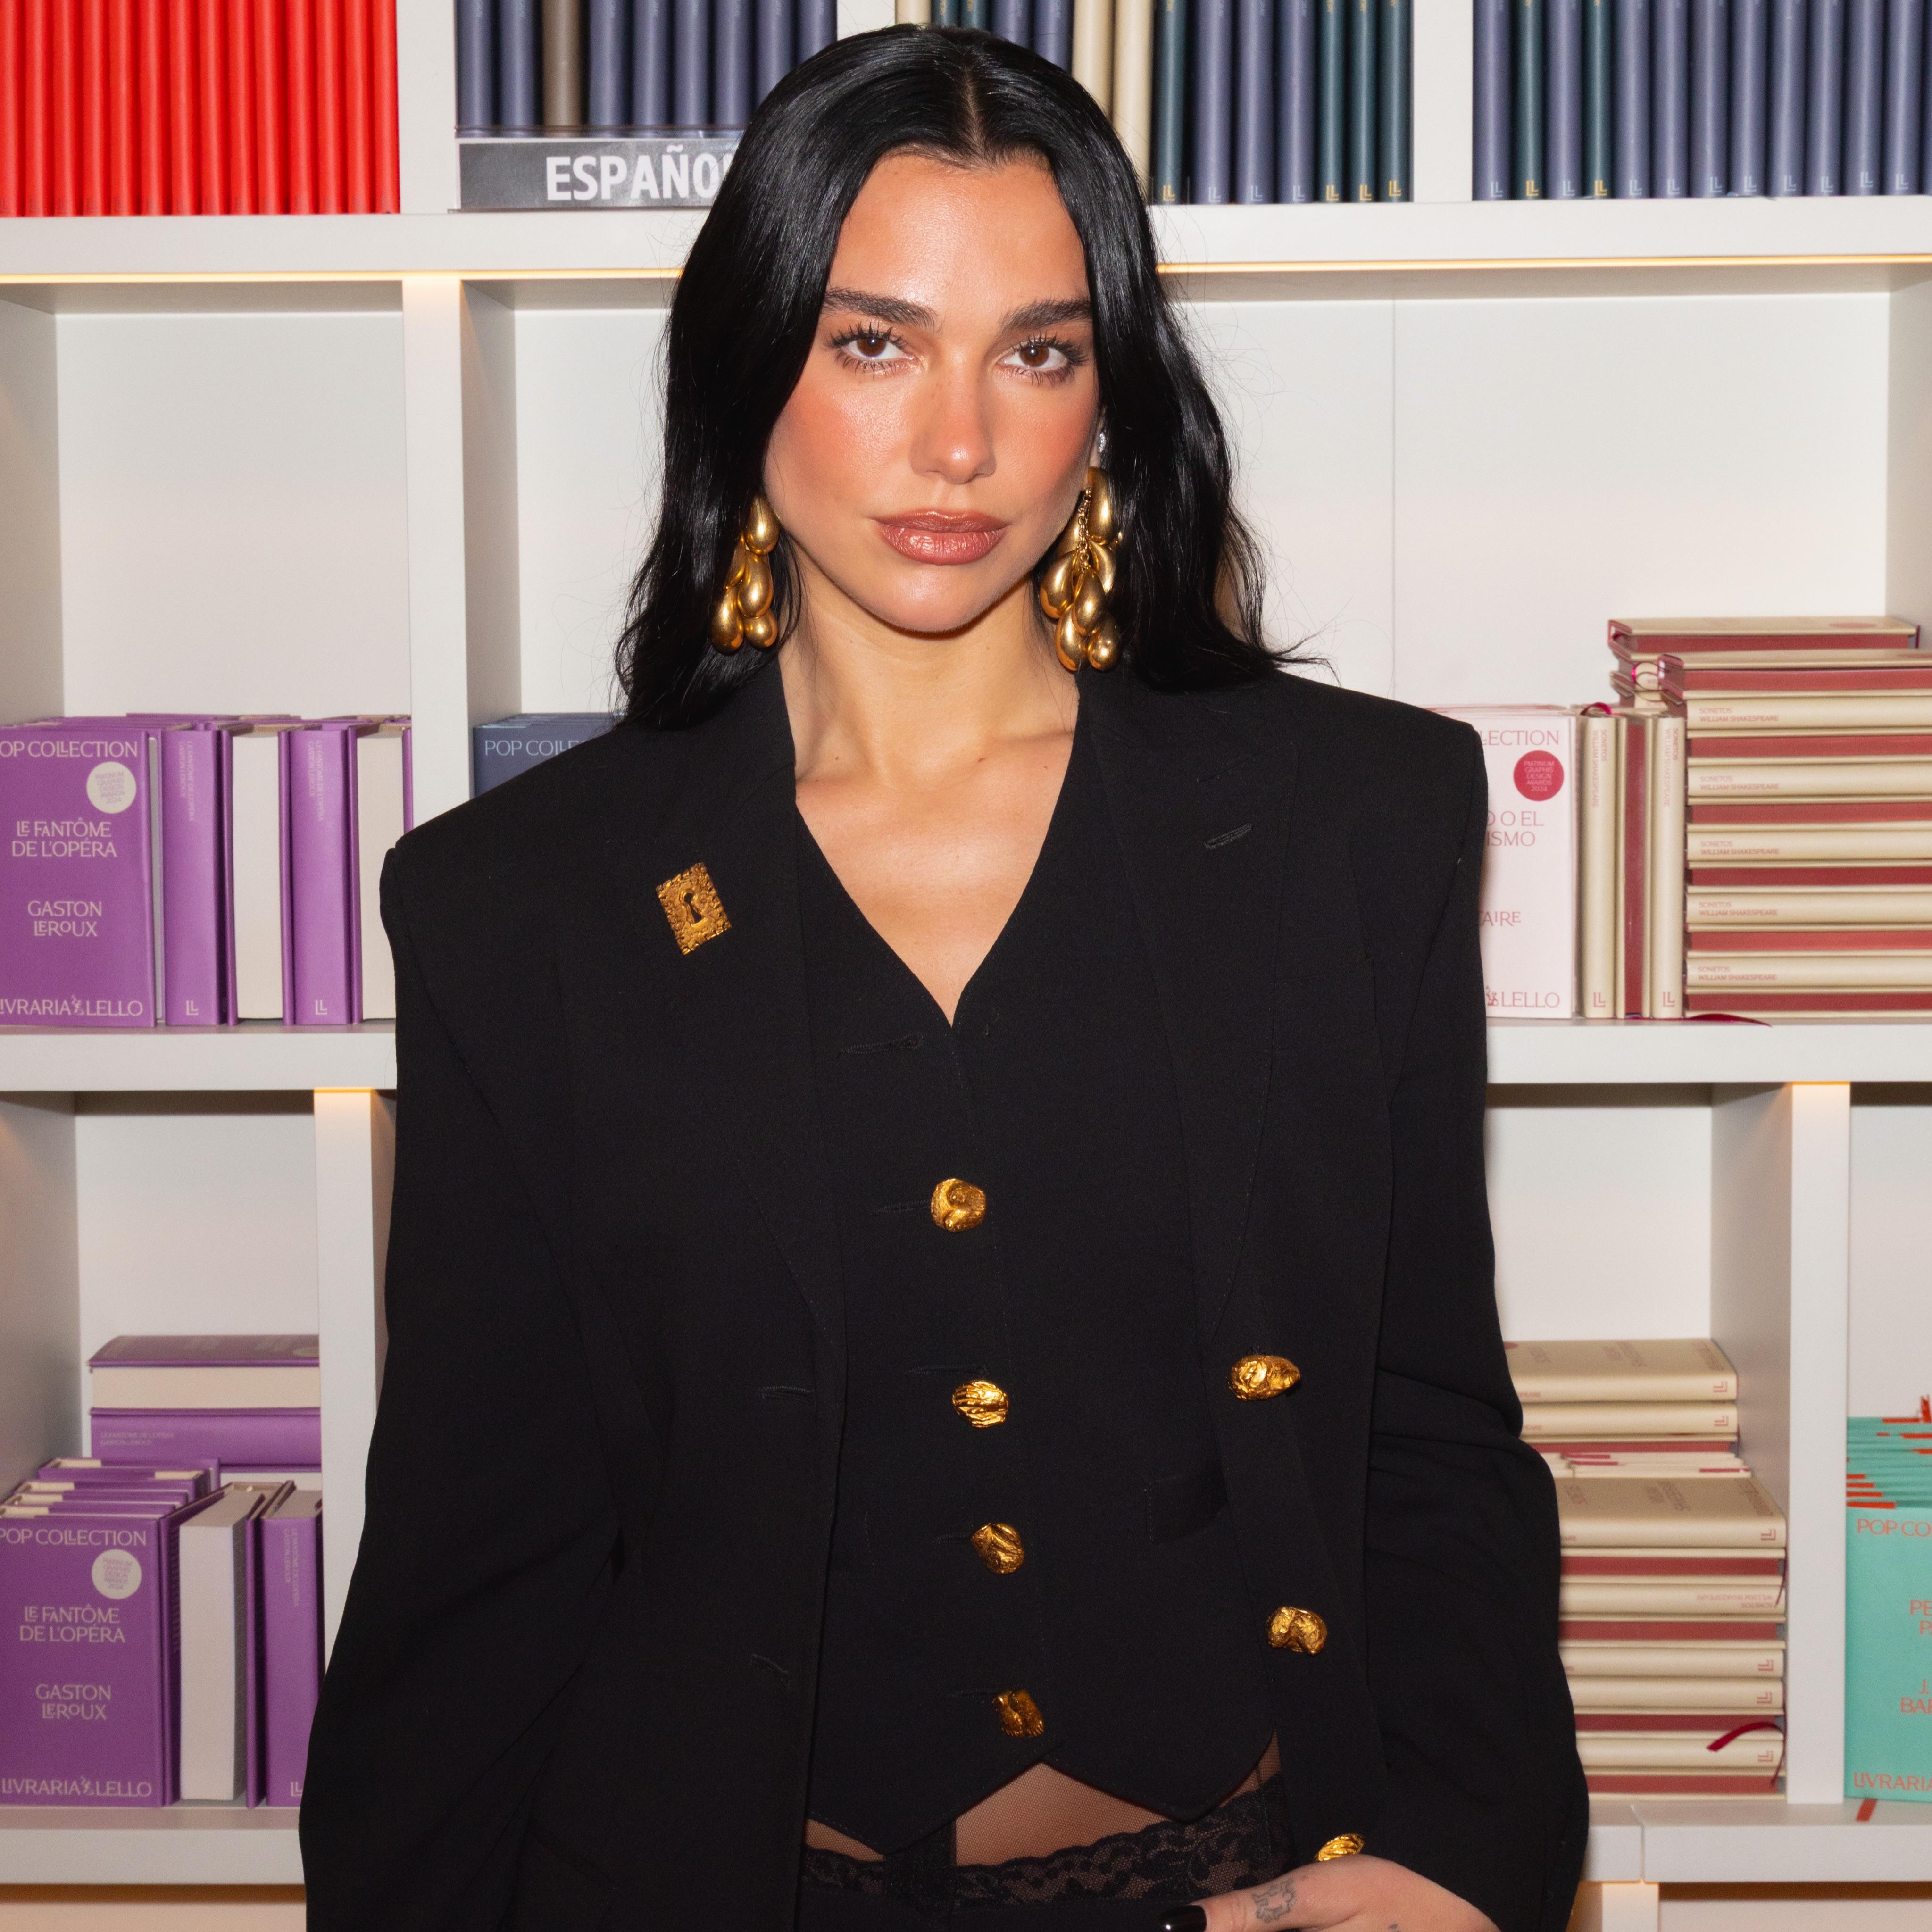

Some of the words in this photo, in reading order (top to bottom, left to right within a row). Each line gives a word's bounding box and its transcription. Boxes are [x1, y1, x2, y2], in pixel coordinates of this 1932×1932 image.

[546, 144, 733, 200] ESPAÑO
[0, 741, 25, 757] OP
[28, 741, 138, 758] COLLECTION
[485, 740, 522, 755] POP
[17, 821, 30, 837] LE
[34, 817, 112, 837] FANTÔME
[1501, 811, 1516, 826] O
[1521, 811, 1544, 826] EL
[12, 841, 37, 857] DE
[42, 838, 117, 857] L'OPÉRA
[28, 901, 102, 916] GASTON
[34, 921, 98, 936] LEROUX
[0, 999, 71, 1015] IVRARIA
[86, 1000, 143, 1016] LELLO
[1502, 992, 1560, 1008] LELLO
[1857, 1518, 1898, 1536] POP
[36, 1529, 146, 1546] COLLECTION
[25, 1606, 37, 1622] LE
[42, 1604, 120, 1624] FANTÔME
[20, 1625, 46, 1641] DE
[36, 1684, 111, 1701] GASTON
[42, 1703, 106, 1720] LEROUX
[2, 1778, 81, 1796] LIVRARIA
[96, 1781, 152, 1797] LELLO
